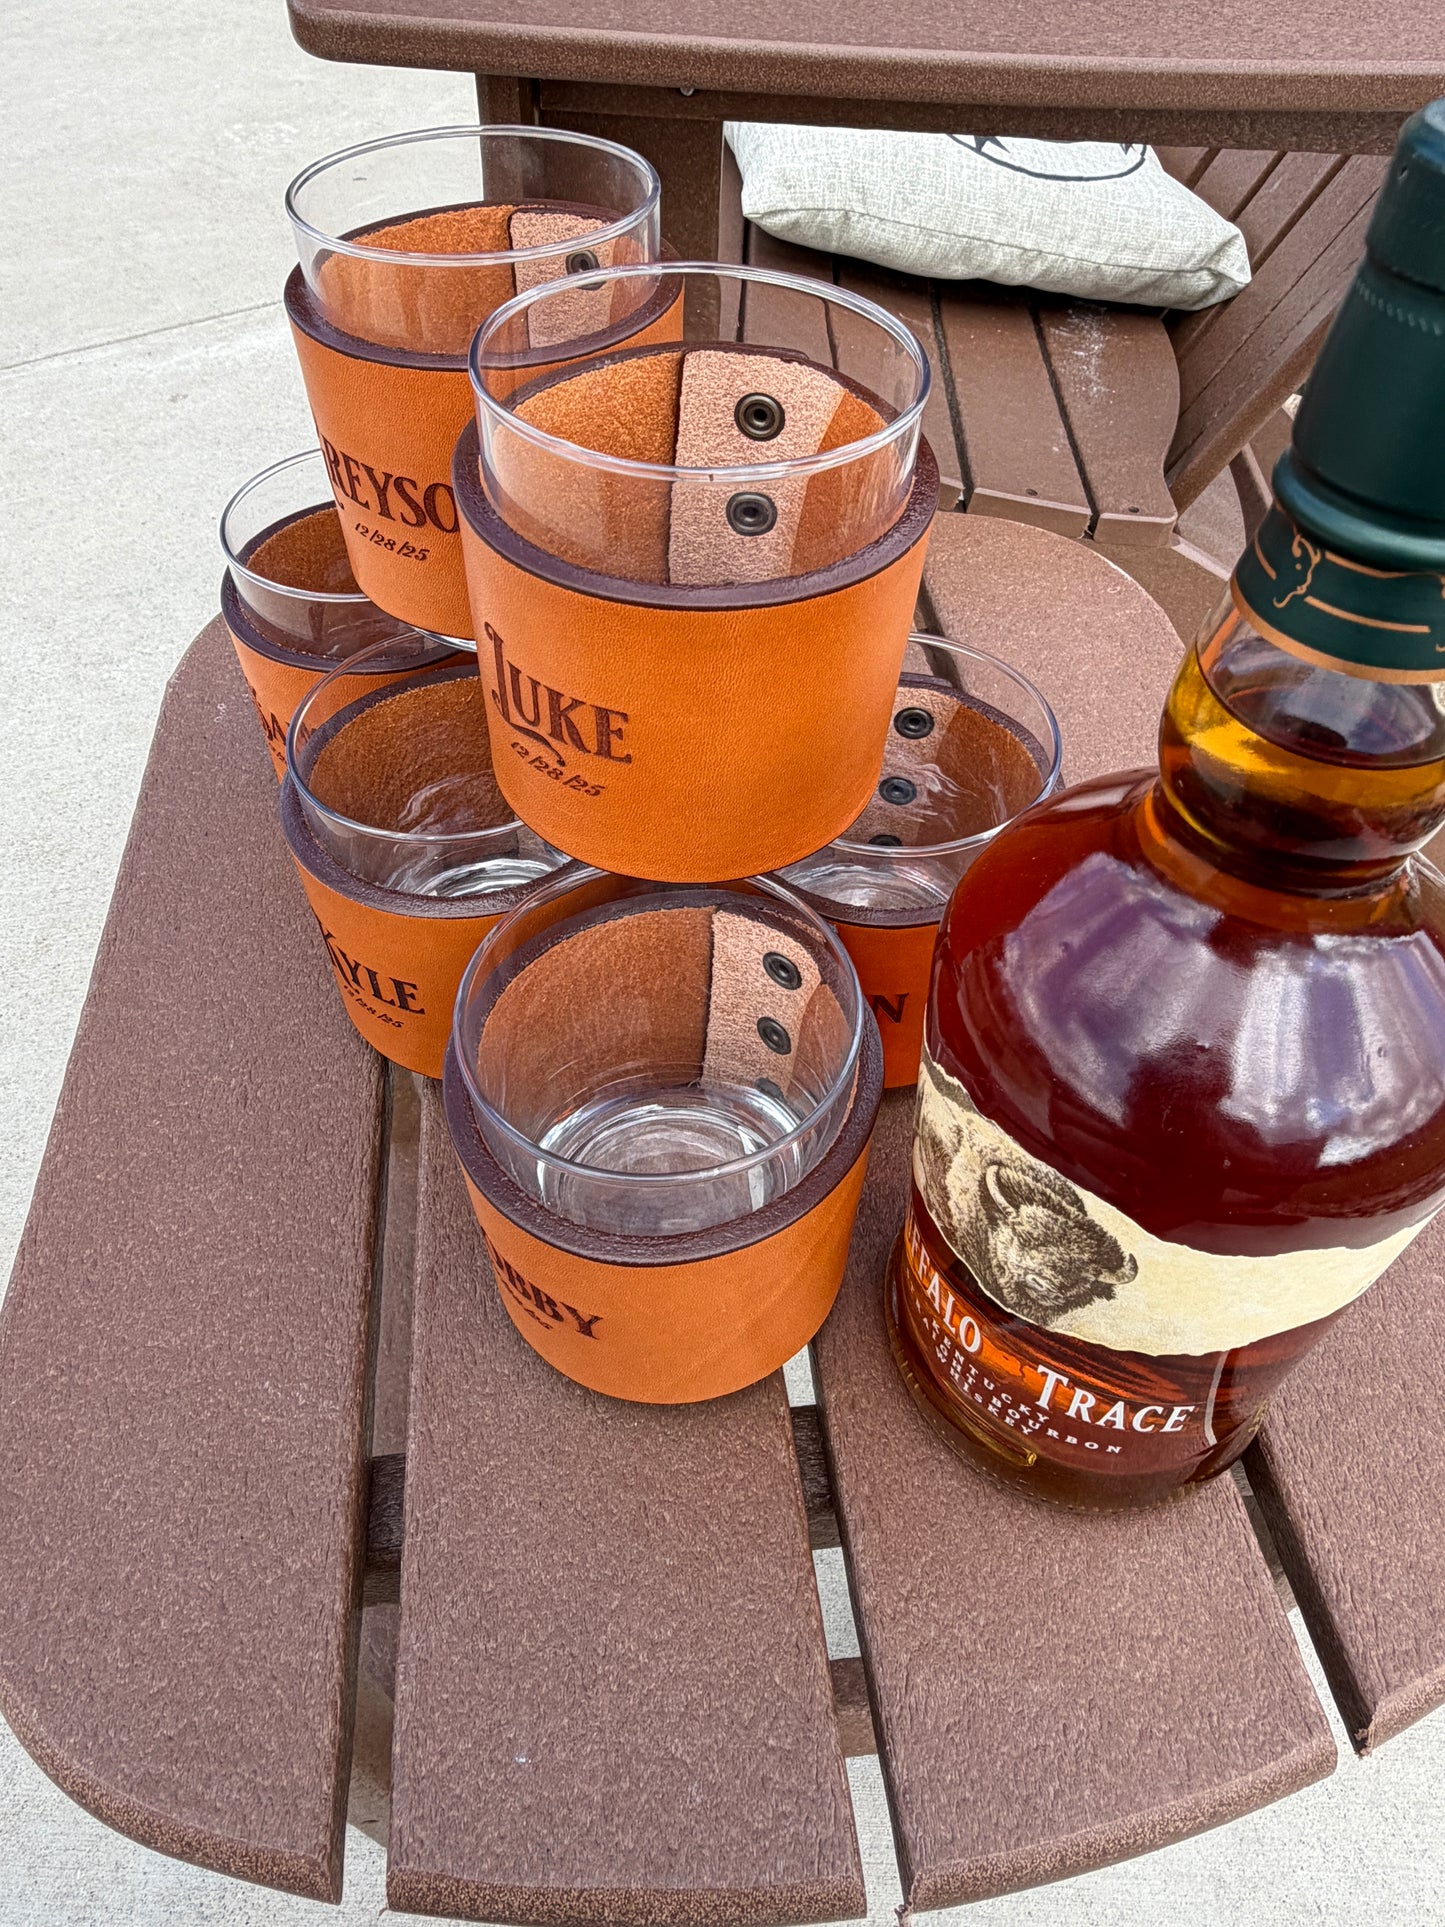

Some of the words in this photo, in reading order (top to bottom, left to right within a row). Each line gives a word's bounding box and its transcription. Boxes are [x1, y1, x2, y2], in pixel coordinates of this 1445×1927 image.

[320, 433, 460, 533] REYSO
[354, 522, 430, 561] 12/28/25
[484, 621, 632, 767] LUKE
[511, 741, 606, 796] 12/28/25
[907, 1197, 981, 1353] FFALO
[1036, 1364, 1195, 1433] TRACE
[991, 1395, 1122, 1454] BOURBON
